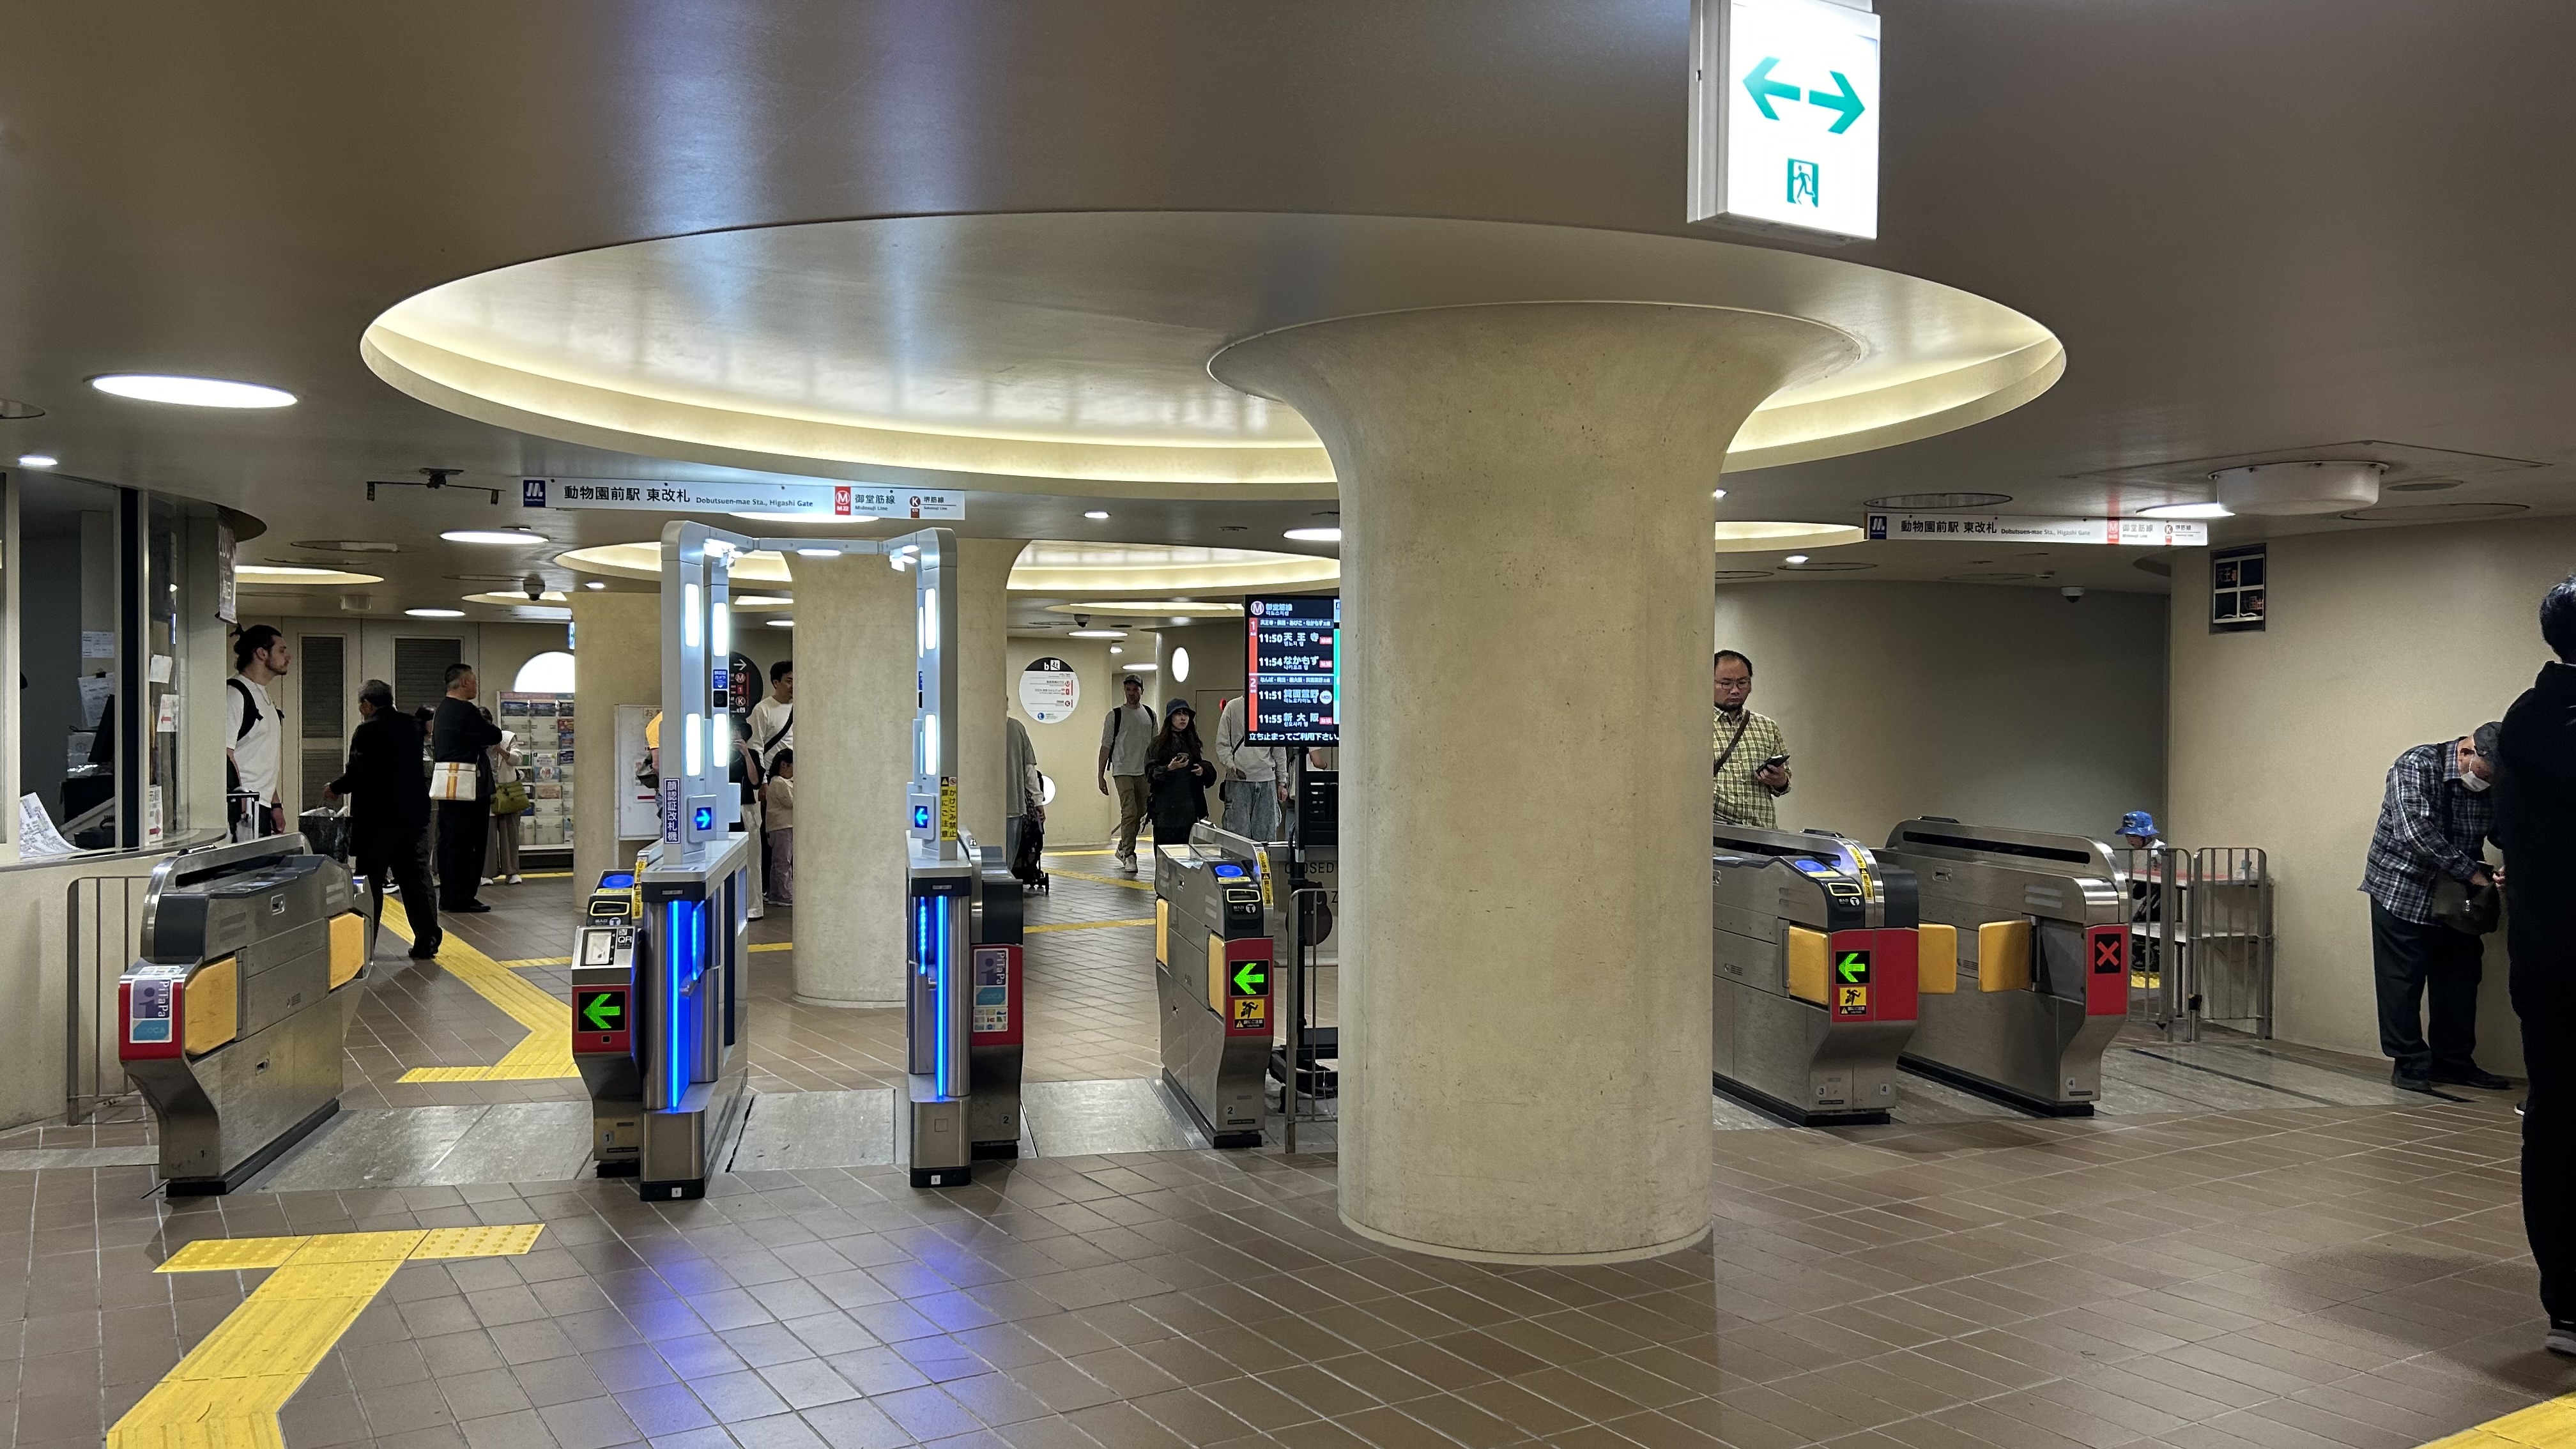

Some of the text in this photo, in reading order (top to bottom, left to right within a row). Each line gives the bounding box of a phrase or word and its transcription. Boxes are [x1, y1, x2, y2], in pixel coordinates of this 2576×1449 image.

[564, 486, 691, 503] 動物園前駅 東改札
[838, 494, 848, 502] M
[855, 494, 895, 504] 御堂筋線
[1901, 520, 1997, 534] 動物園前駅 東改札
[1250, 620, 1255, 631] 1
[1259, 634, 1283, 643] 11:50
[1284, 632, 1319, 642] 天王寺
[1259, 657, 1283, 666] 11:54
[1284, 656, 1319, 665] なかもず
[1044, 662, 1049, 670] b
[1250, 678, 1256, 687] 2
[1259, 691, 1282, 700] 11:51
[1259, 714, 1282, 723] 11:55
[667, 781, 677, 841] 顔認証改札機
[1284, 862, 1335, 873] COSED
[997, 952, 1006, 985] PiTaPa
[158, 980, 170, 1017] PiTaPa
